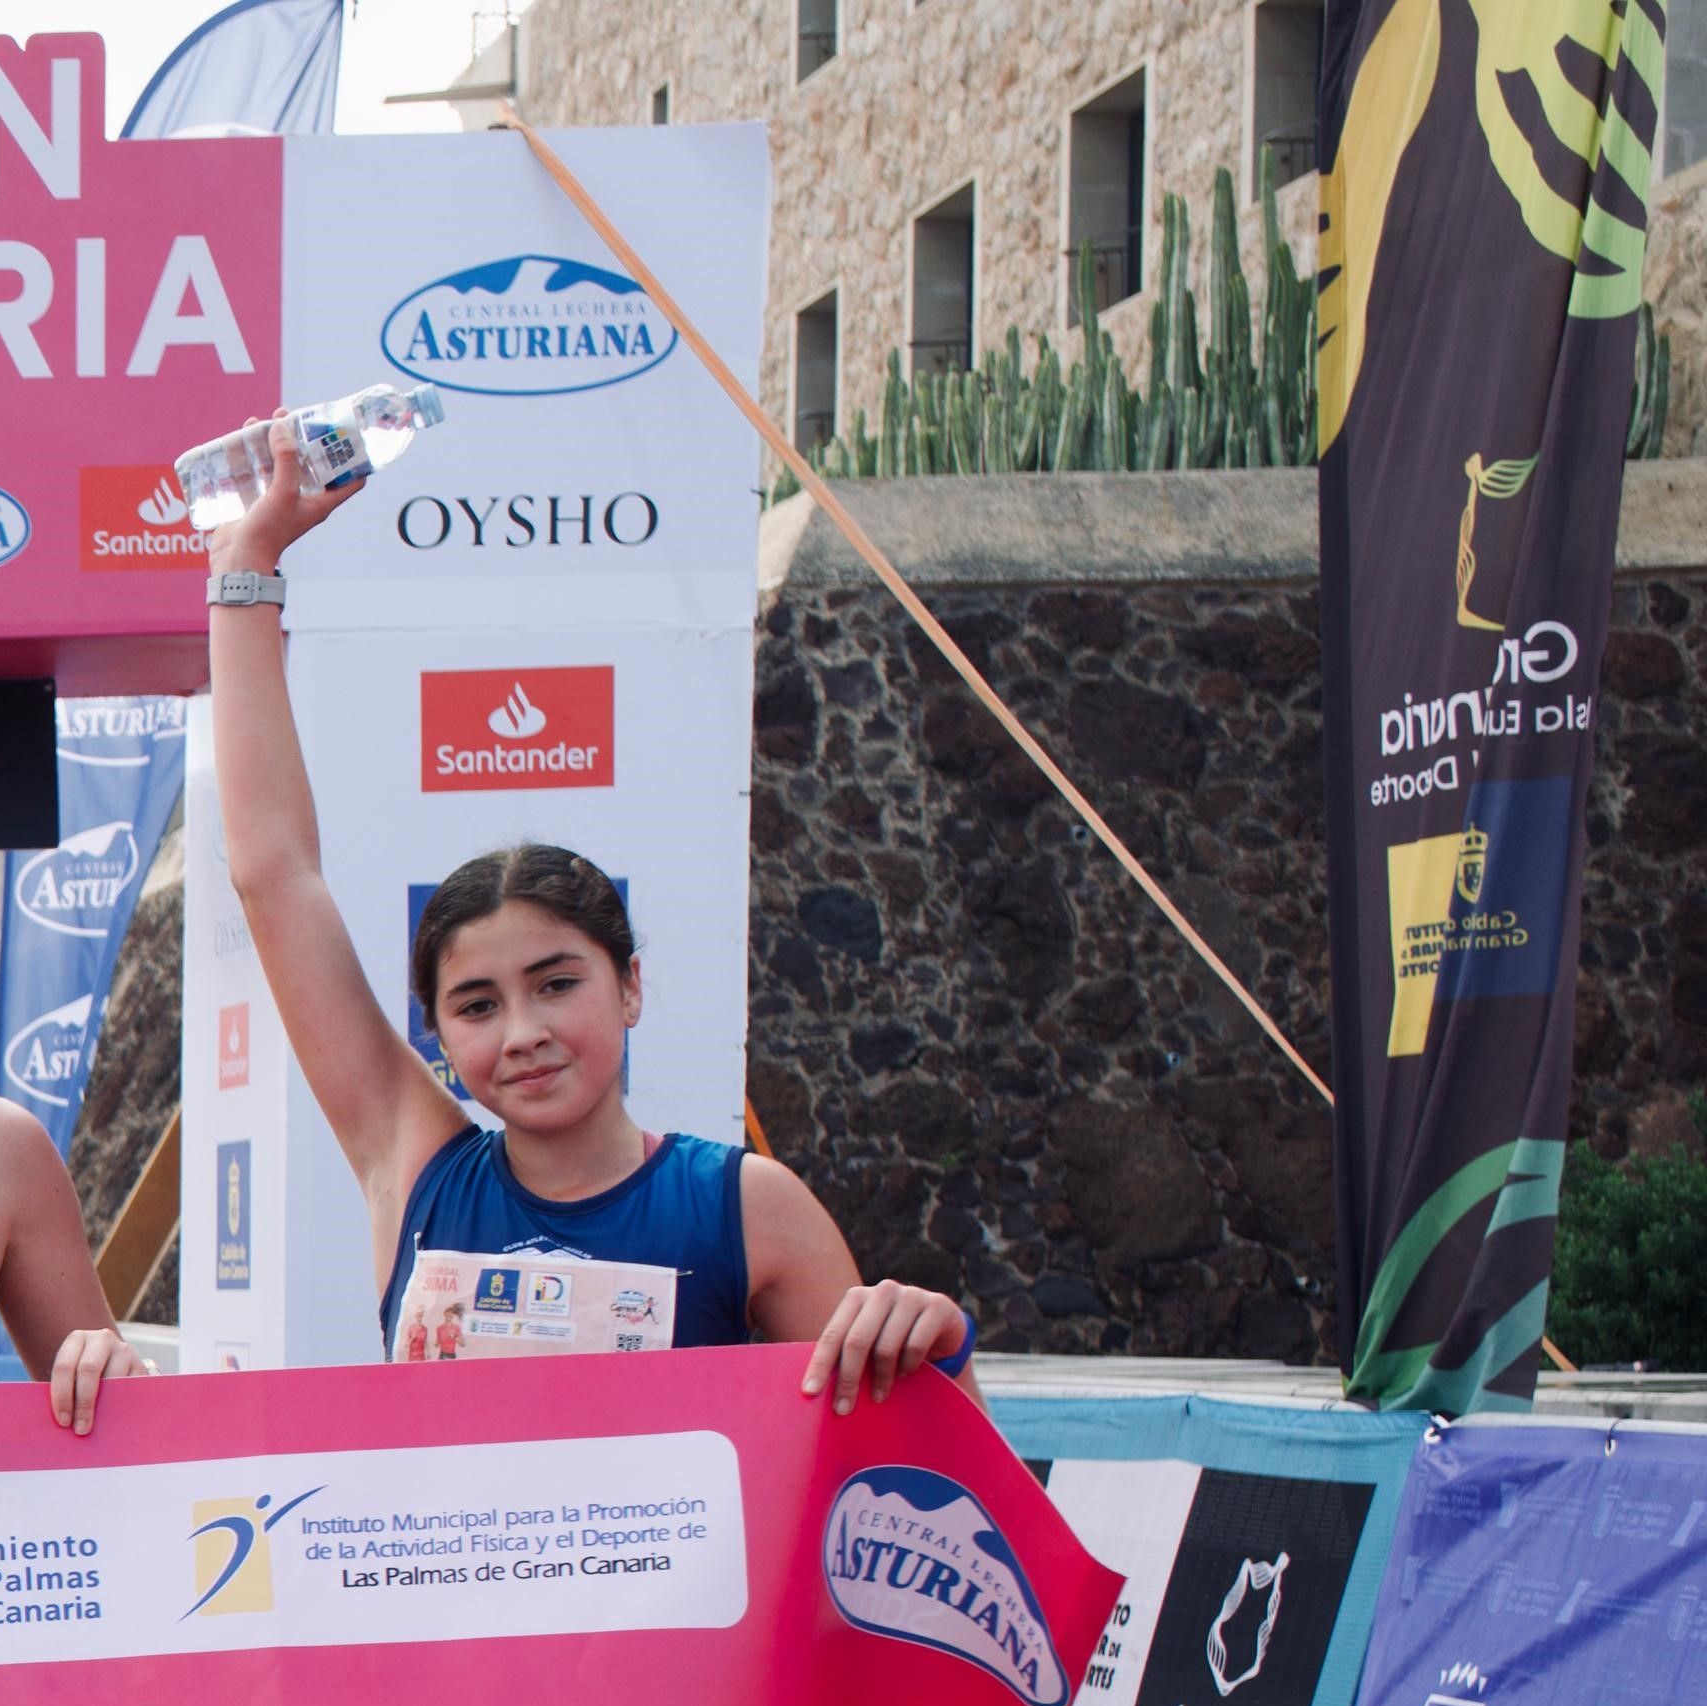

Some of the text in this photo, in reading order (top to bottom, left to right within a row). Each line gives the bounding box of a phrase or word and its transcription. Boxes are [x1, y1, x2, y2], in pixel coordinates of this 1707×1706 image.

[450, 302, 648, 320] CENTRAL LECHERA
[403, 309, 656, 362] ASTURIANA
[397, 491, 659, 549] OYSHO
[436, 741, 599, 776] Santander
[301, 1496, 706, 1535] Instituto Municipal para la Promoción
[305, 1522, 707, 1561] de la Actividad Física y el Deporte de
[342, 1552, 671, 1588] Las Palmas de Gran Canaria
[857, 1509, 963, 1560] CENTRAL
[970, 1558, 1044, 1656] LECHERA
[830, 1509, 1042, 1699] ASTURIANA
